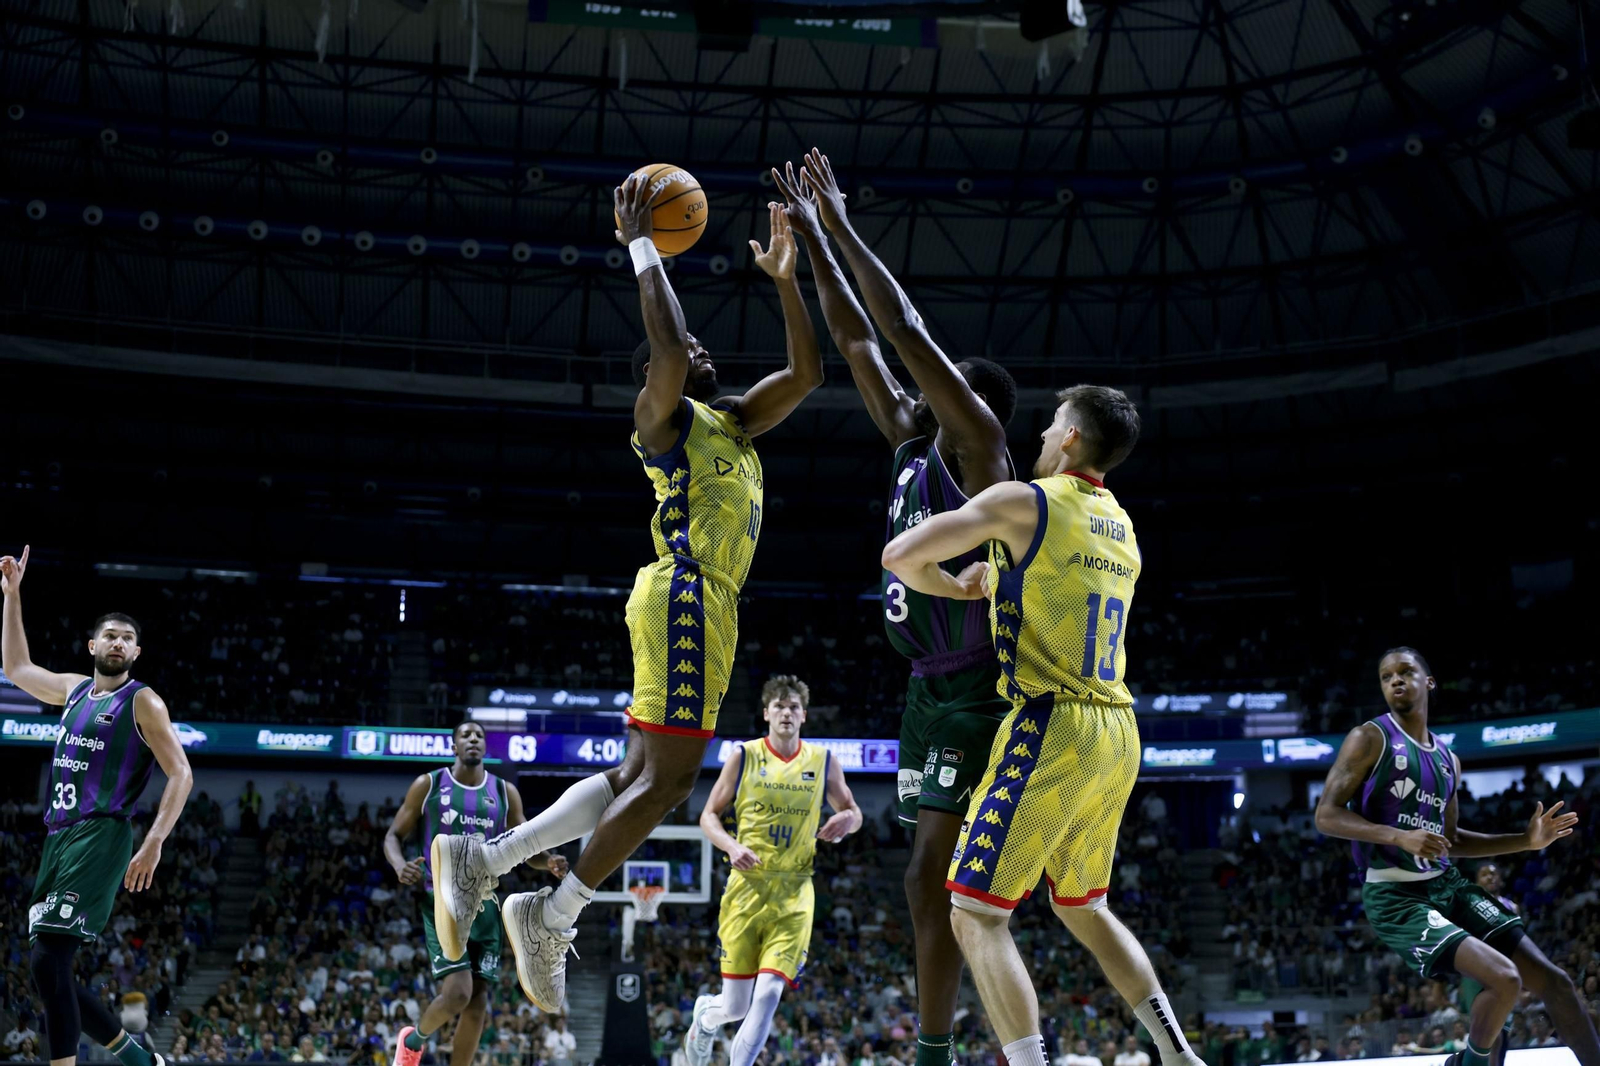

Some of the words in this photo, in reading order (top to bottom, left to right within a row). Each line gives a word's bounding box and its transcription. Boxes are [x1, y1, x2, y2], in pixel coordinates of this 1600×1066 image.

[737, 462, 763, 491] Ando
[1084, 555, 1134, 581] MORABANC
[886, 582, 909, 623] 3
[1081, 593, 1125, 681] 13
[2, 719, 60, 741] Europc
[257, 729, 333, 749] Europcar
[1482, 721, 1557, 743] Europcar
[65, 732, 105, 751] Unicaja
[390, 734, 454, 757] UNICAJ
[508, 735, 537, 762] 63
[944, 752, 958, 761] acb
[1143, 746, 1216, 765] Europcar
[52, 782, 77, 811] 33
[763, 781, 815, 793] MORABANC
[459, 814, 494, 828] Unicaja
[769, 823, 792, 849] 44
